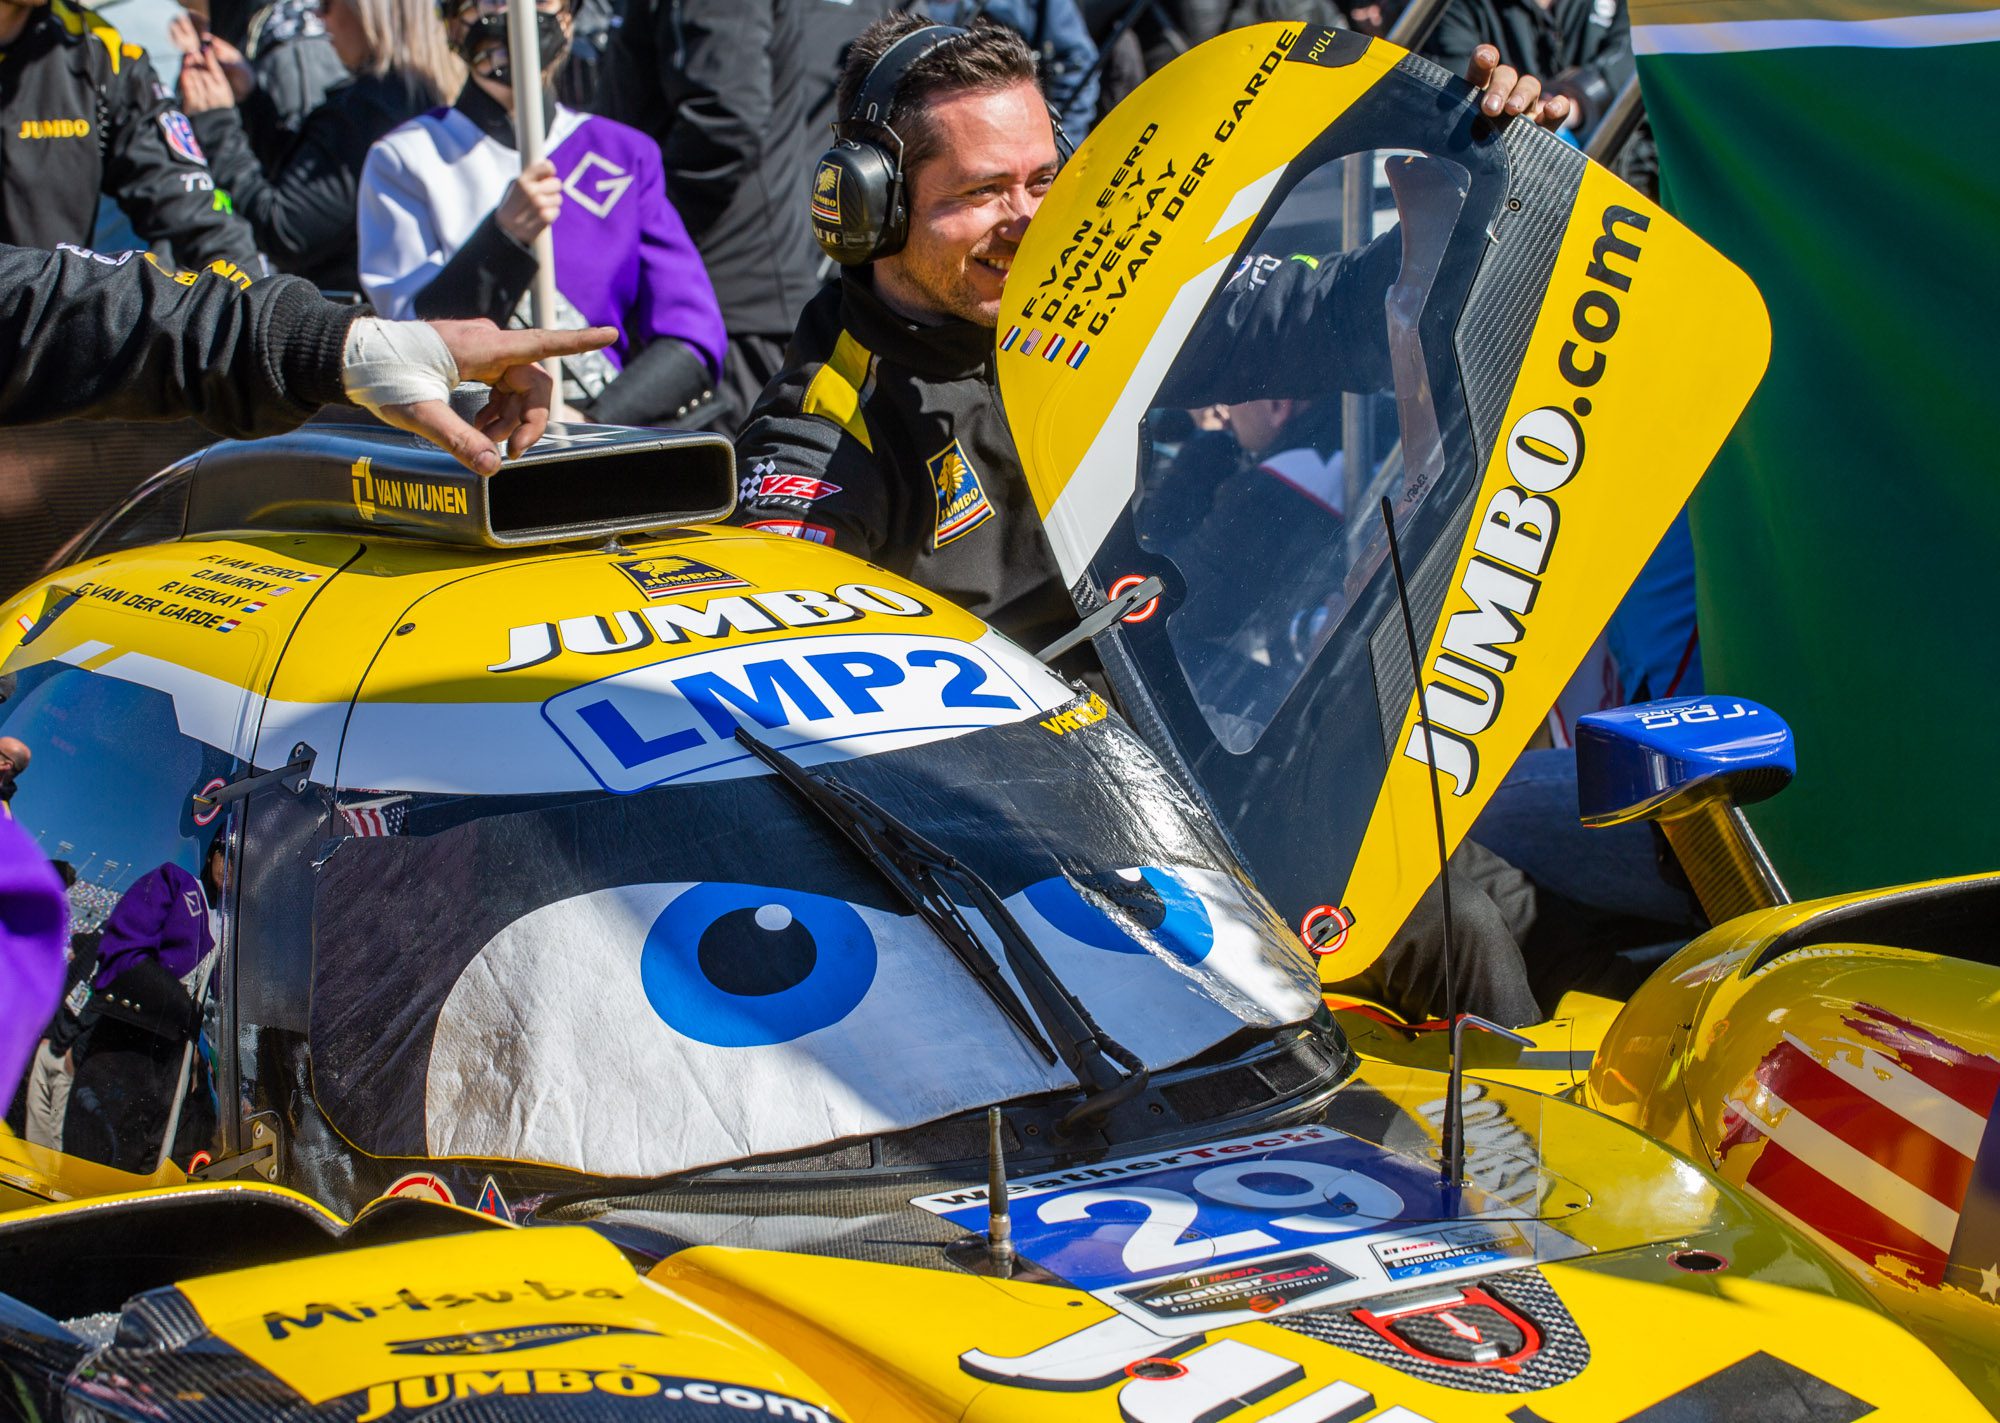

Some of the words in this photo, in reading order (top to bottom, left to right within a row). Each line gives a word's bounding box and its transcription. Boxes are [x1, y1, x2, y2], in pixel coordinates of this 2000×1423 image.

[1308, 30, 1336, 62] PULL
[18, 119, 90, 139] JUMBO
[1162, 152, 1215, 222] DER
[1214, 29, 1297, 142] GARDE
[1096, 122, 1159, 208] EERD
[375, 478, 402, 507] VAN
[403, 482, 468, 514] WIJNEN
[940, 488, 979, 523] JUMBO
[1403, 204, 1651, 797] JUMBO.com
[191, 570, 277, 593] D.MURRY
[251, 565, 304, 580] EERD
[643, 571, 724, 587] JUMBO
[123, 592, 163, 612] DER
[159, 602, 225, 629] GARDE
[158, 581, 250, 609] R.VEEKAY
[487, 583, 934, 673] JUMBO
[576, 649, 1024, 770] LMP2
[1037, 1159, 1405, 1273] 29
[1391, 1245, 1483, 1268] ENDURANCE
[1401, 1240, 1441, 1252] IMSA
[1144, 1264, 1330, 1308] WeatherTech
[1208, 1267, 1264, 1284] IMSA
[1171, 1293, 1239, 1313] SPORTSCAR
[1243, 1275, 1329, 1298] CHAMPIONSHIP
